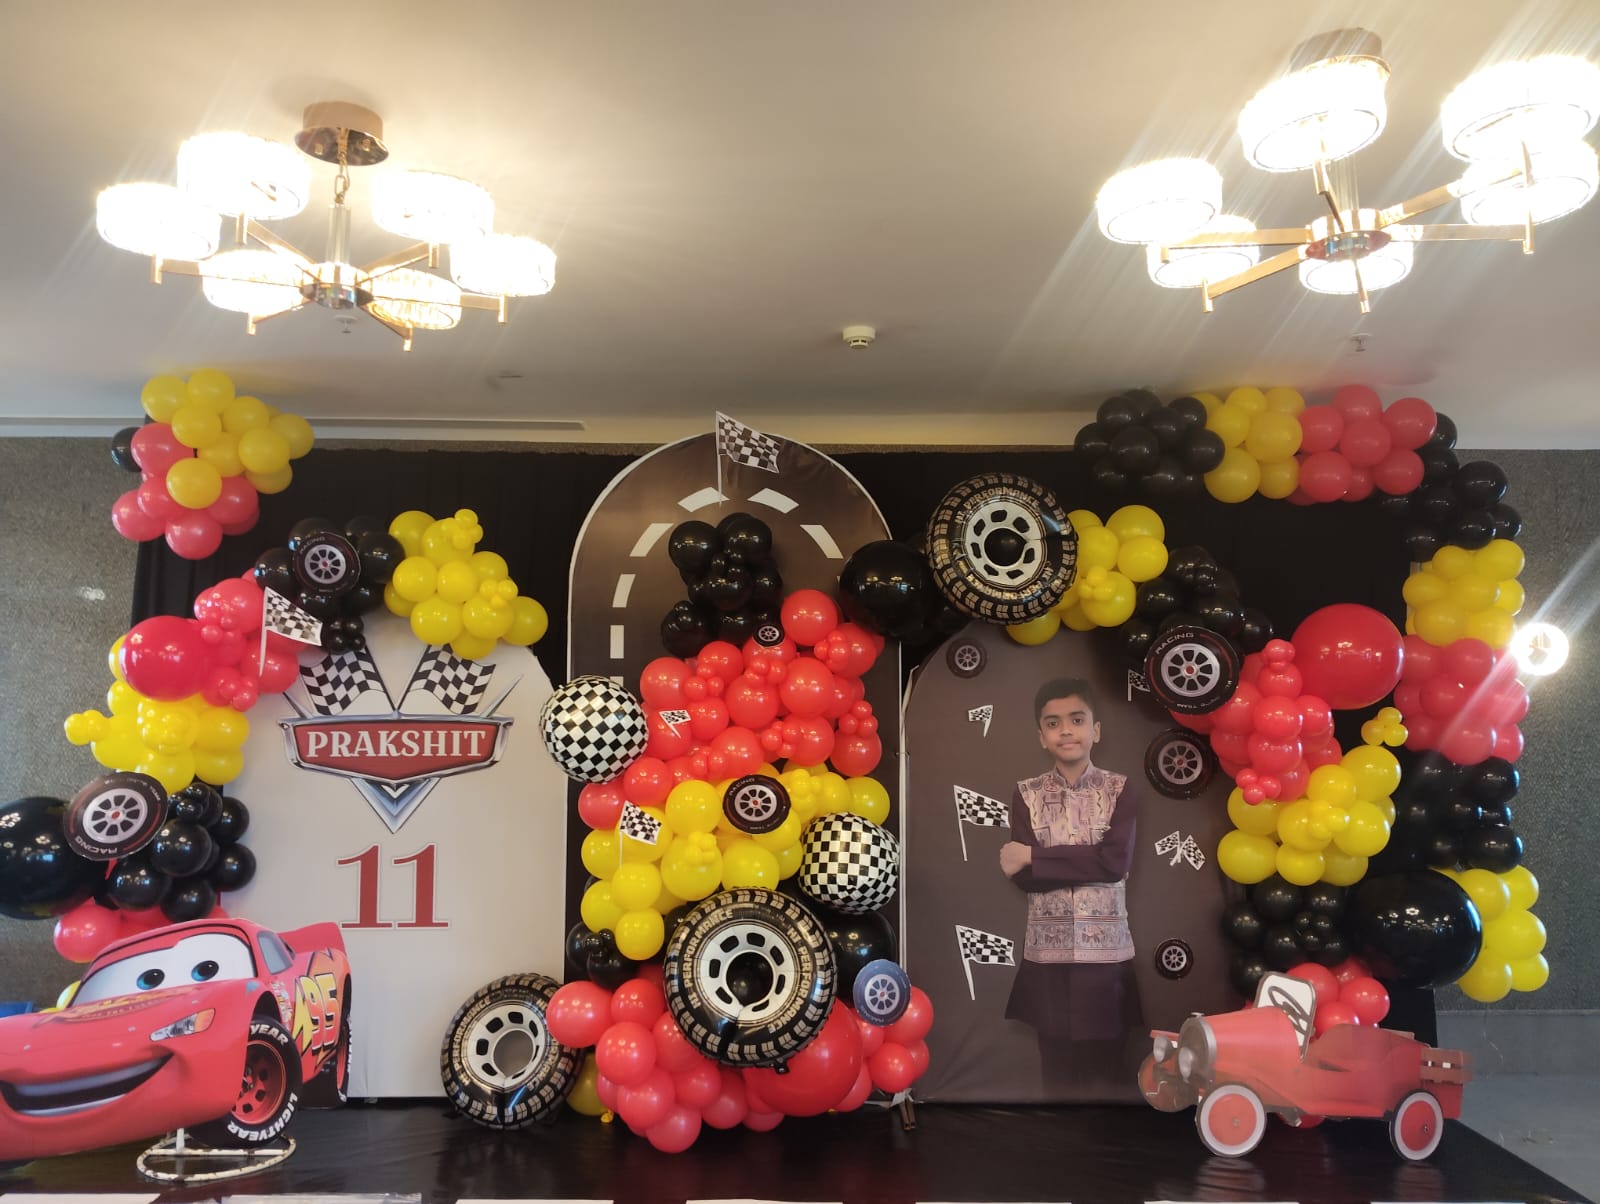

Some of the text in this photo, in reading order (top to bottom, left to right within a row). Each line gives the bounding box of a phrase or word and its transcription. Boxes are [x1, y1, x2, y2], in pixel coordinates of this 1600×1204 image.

[1155, 632, 1195, 655] RACING
[306, 729, 486, 758] PRAKSHIT
[74, 835, 118, 855] RACING
[337, 843, 449, 929] 11
[682, 908, 734, 988] PERFORMANCE
[300, 972, 339, 1054] 95
[767, 946, 813, 1034] PERFORMANCE
[227, 1092, 298, 1142] LIGHTYEAR
